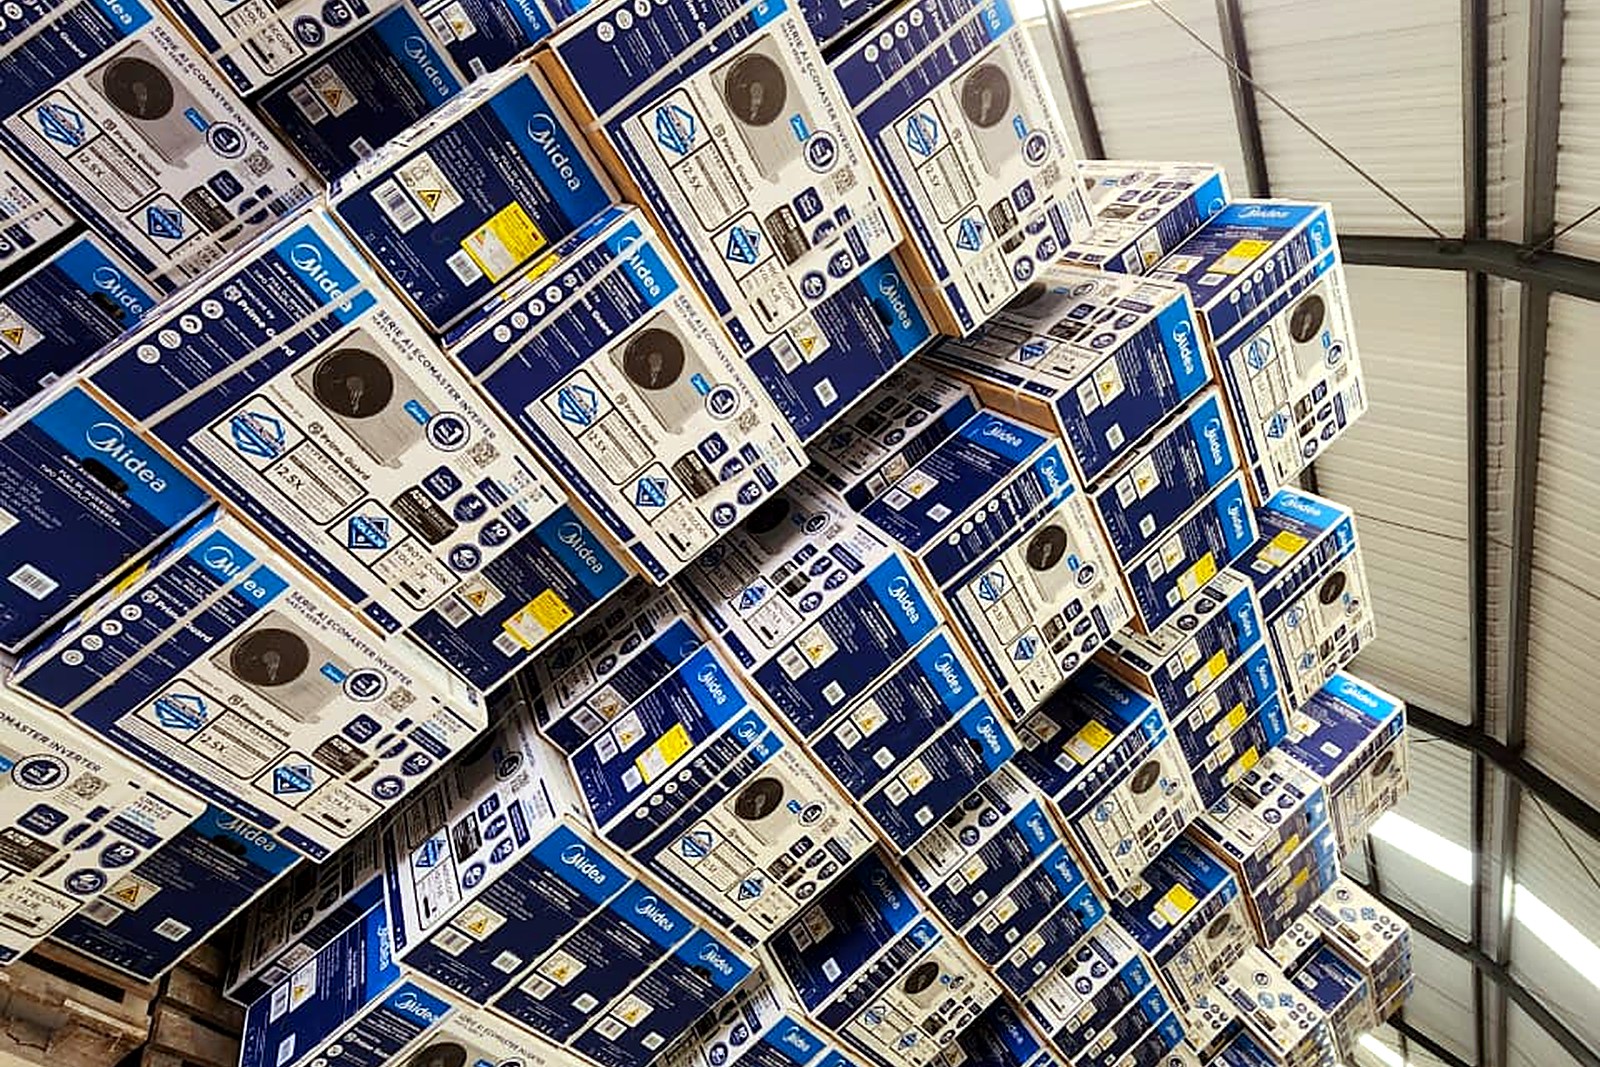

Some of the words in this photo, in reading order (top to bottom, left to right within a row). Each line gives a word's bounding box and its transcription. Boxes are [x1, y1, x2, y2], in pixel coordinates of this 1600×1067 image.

[332, 3, 349, 20] 10
[404, 36, 449, 97] Midea
[75, 151, 105, 179] 12.5X
[527, 113, 580, 192] Midea
[680, 160, 703, 193] 12.5X
[734, 163, 754, 192] Guard
[837, 252, 852, 270] 10
[234, 299, 268, 329] Prime
[879, 273, 912, 329] Midea
[1172, 319, 1195, 376] Midea
[86, 422, 167, 493] Midea
[317, 432, 347, 458] Prime
[342, 454, 372, 481] Guard
[272, 462, 306, 491] 12.5X
[746, 481, 761, 498] 10
[490, 521, 509, 538] 10
[557, 523, 604, 574] Midea
[888, 574, 920, 625] Midea
[697, 662, 727, 706] Midea
[934, 652, 963, 695] Midea
[239, 702, 268, 722] Prime
[265, 719, 292, 738] Guard
[47, 736, 102, 776] INVERTER
[275, 767, 311, 792] VOLTAJE
[112, 843, 135, 859] 10
[214, 810, 277, 854] Midea
[560, 843, 606, 885] Midea
[635, 895, 676, 933] Midea
